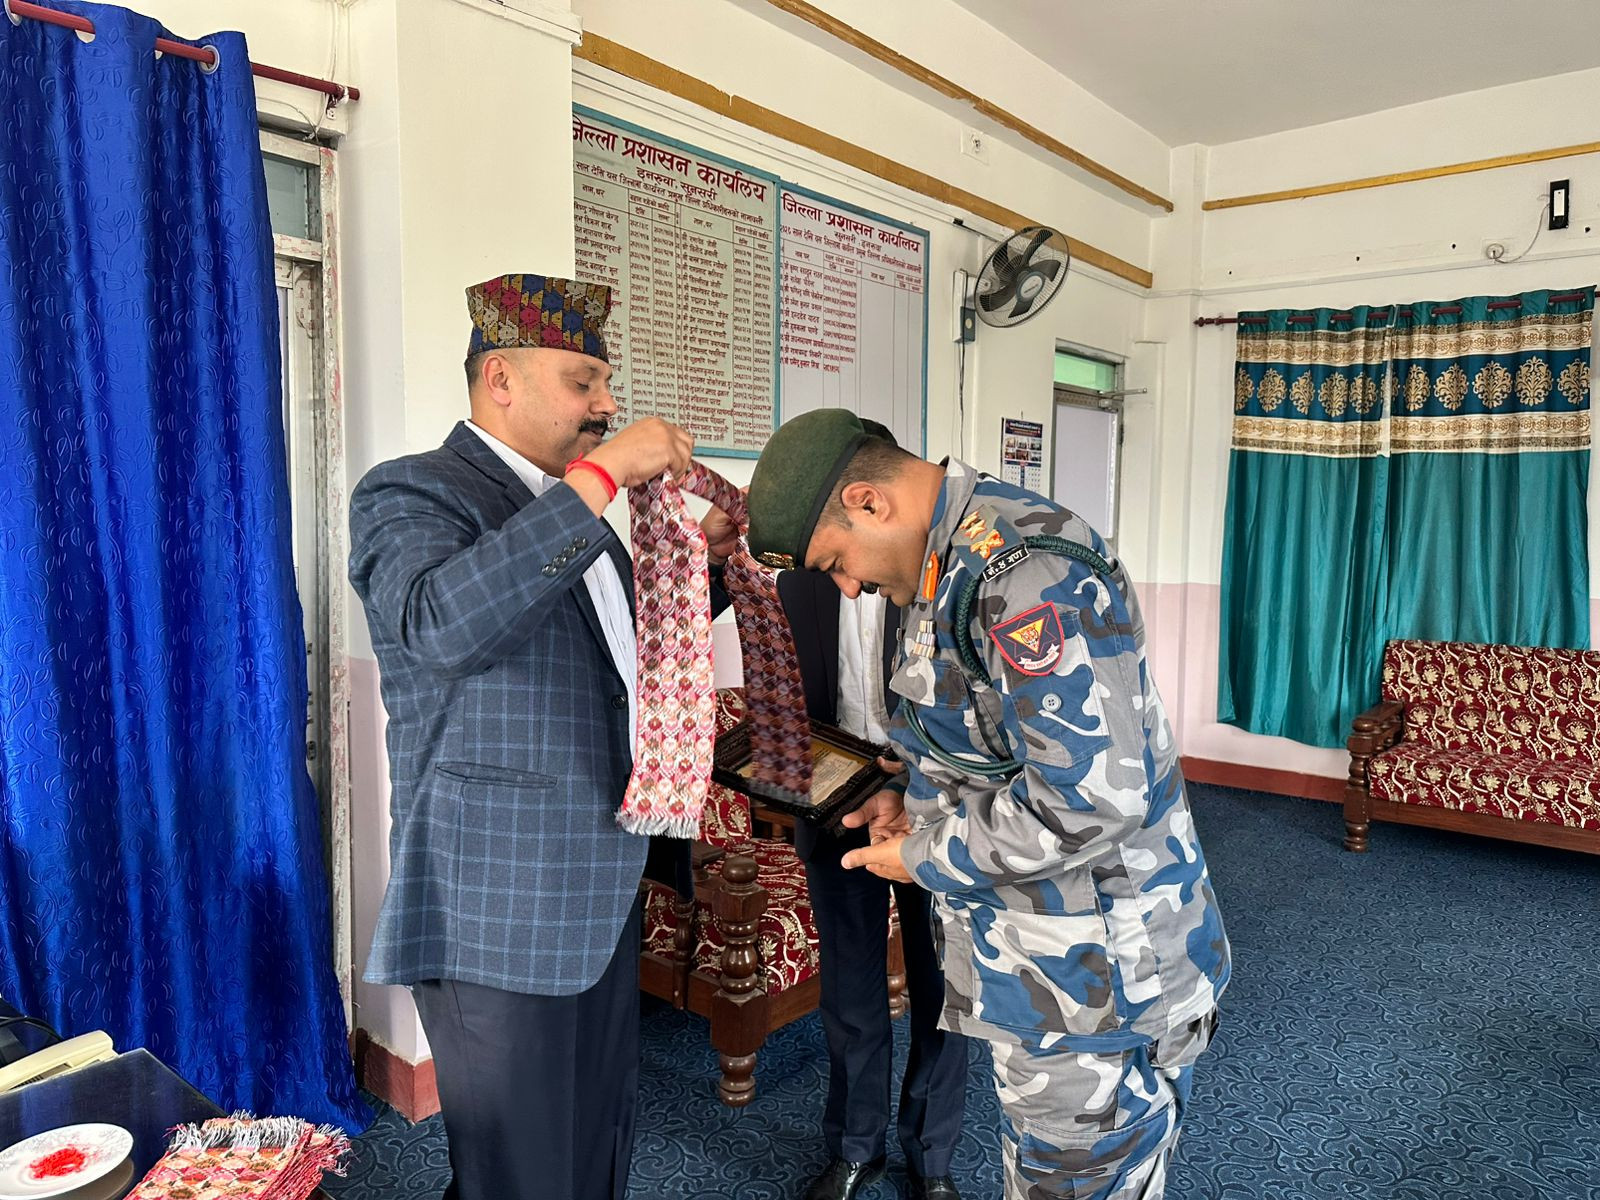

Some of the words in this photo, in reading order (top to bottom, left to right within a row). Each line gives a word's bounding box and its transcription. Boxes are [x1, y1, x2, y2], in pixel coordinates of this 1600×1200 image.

[622, 137, 691, 176] प्रशासन
[696, 162, 766, 202] कार्यालय
[780, 191, 822, 222] जिल्ला
[826, 211, 874, 238] प्रशासन
[878, 229, 920, 253] कार्यालय
